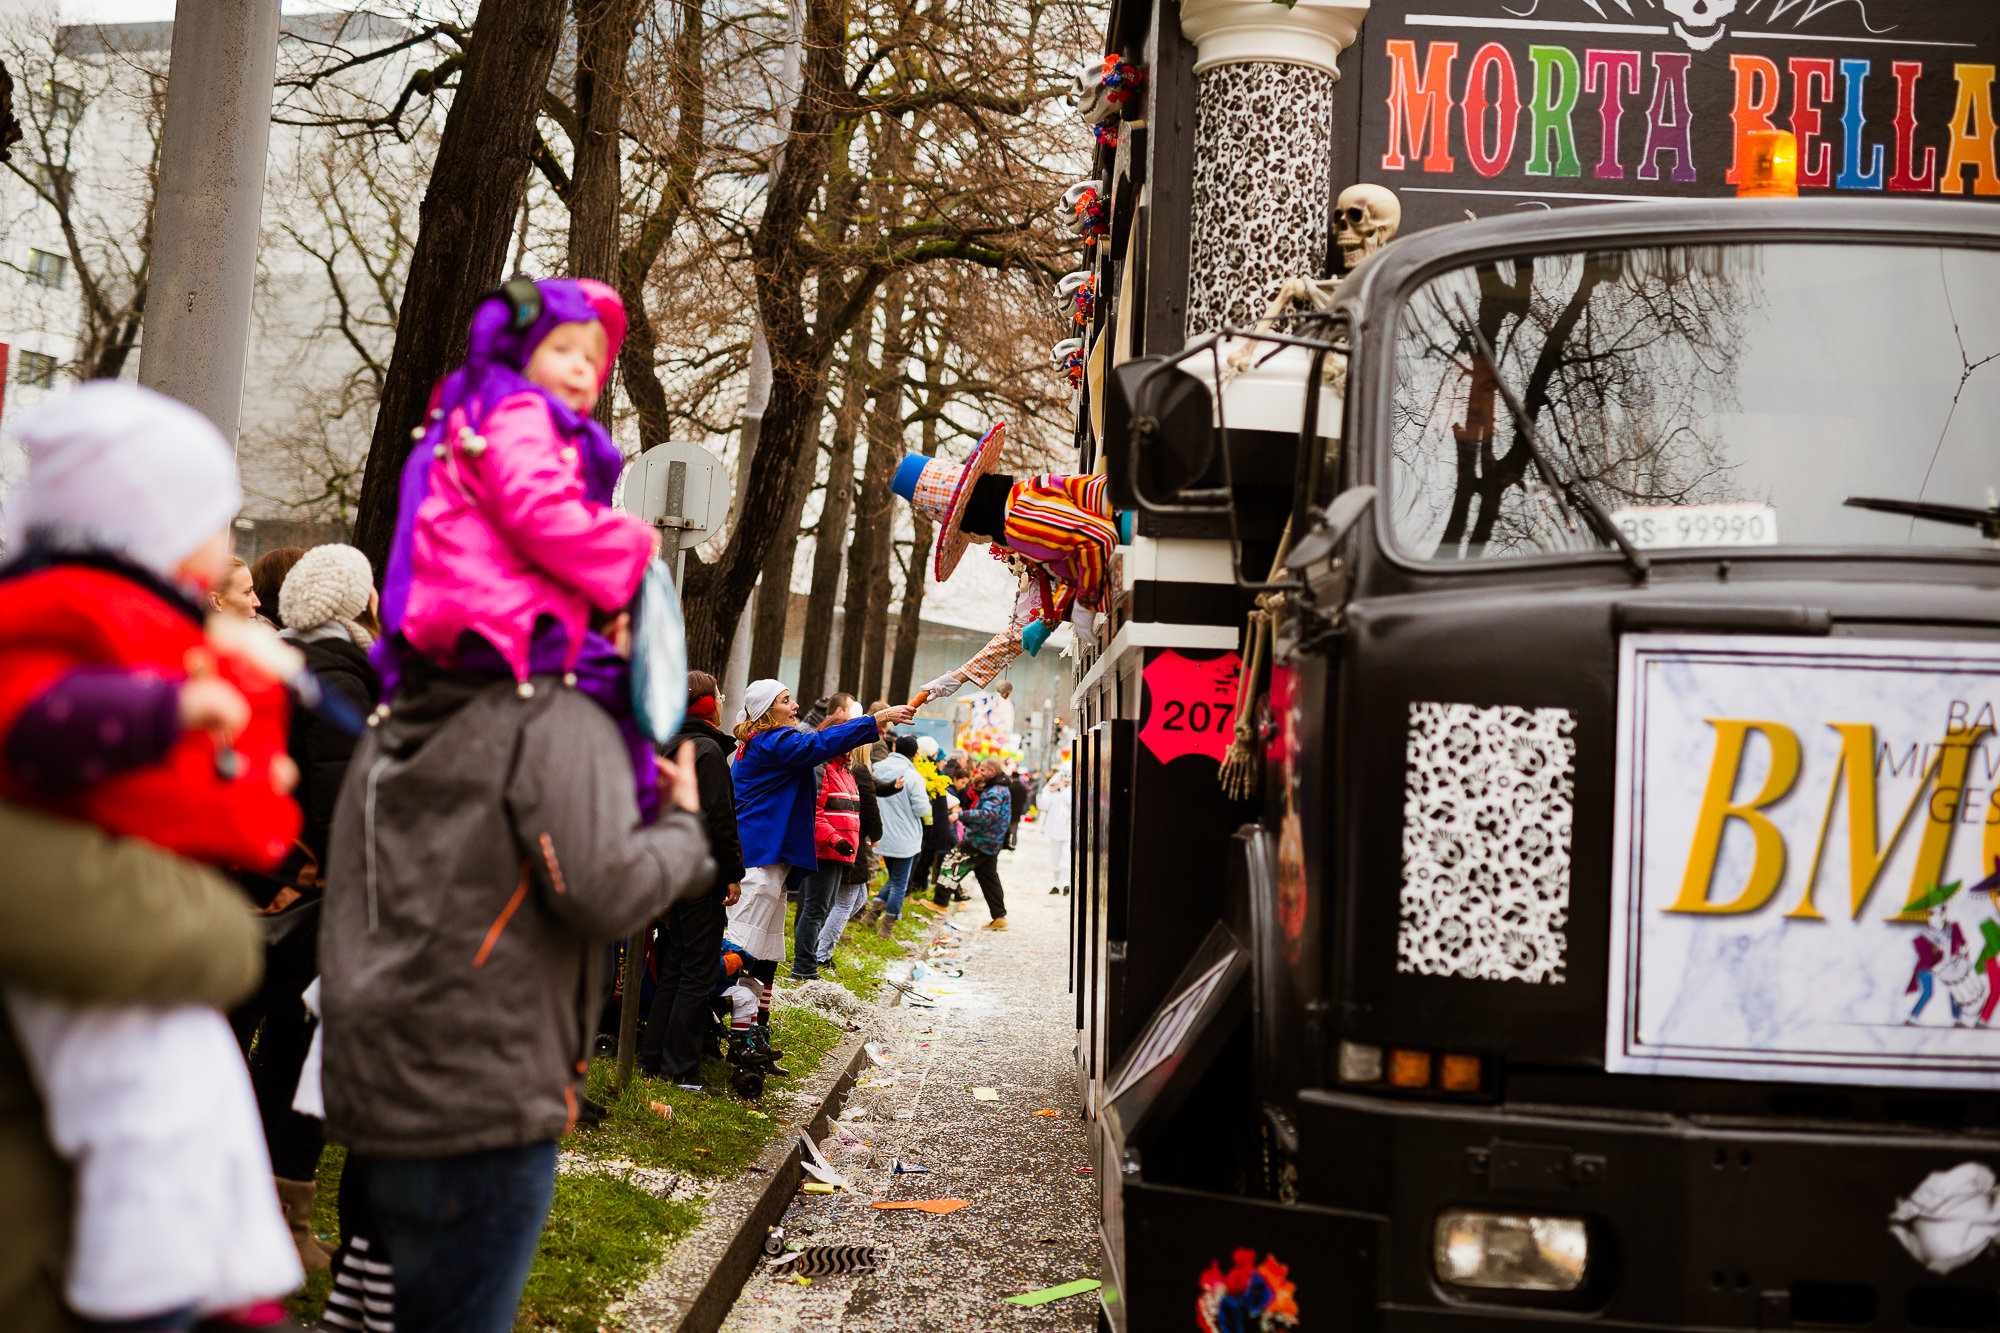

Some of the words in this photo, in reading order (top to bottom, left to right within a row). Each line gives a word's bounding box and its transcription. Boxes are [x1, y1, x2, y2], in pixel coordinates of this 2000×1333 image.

[1381, 38, 1697, 183] MORTA
[1725, 53, 2000, 196] BELLA
[1162, 700, 1234, 734] 207
